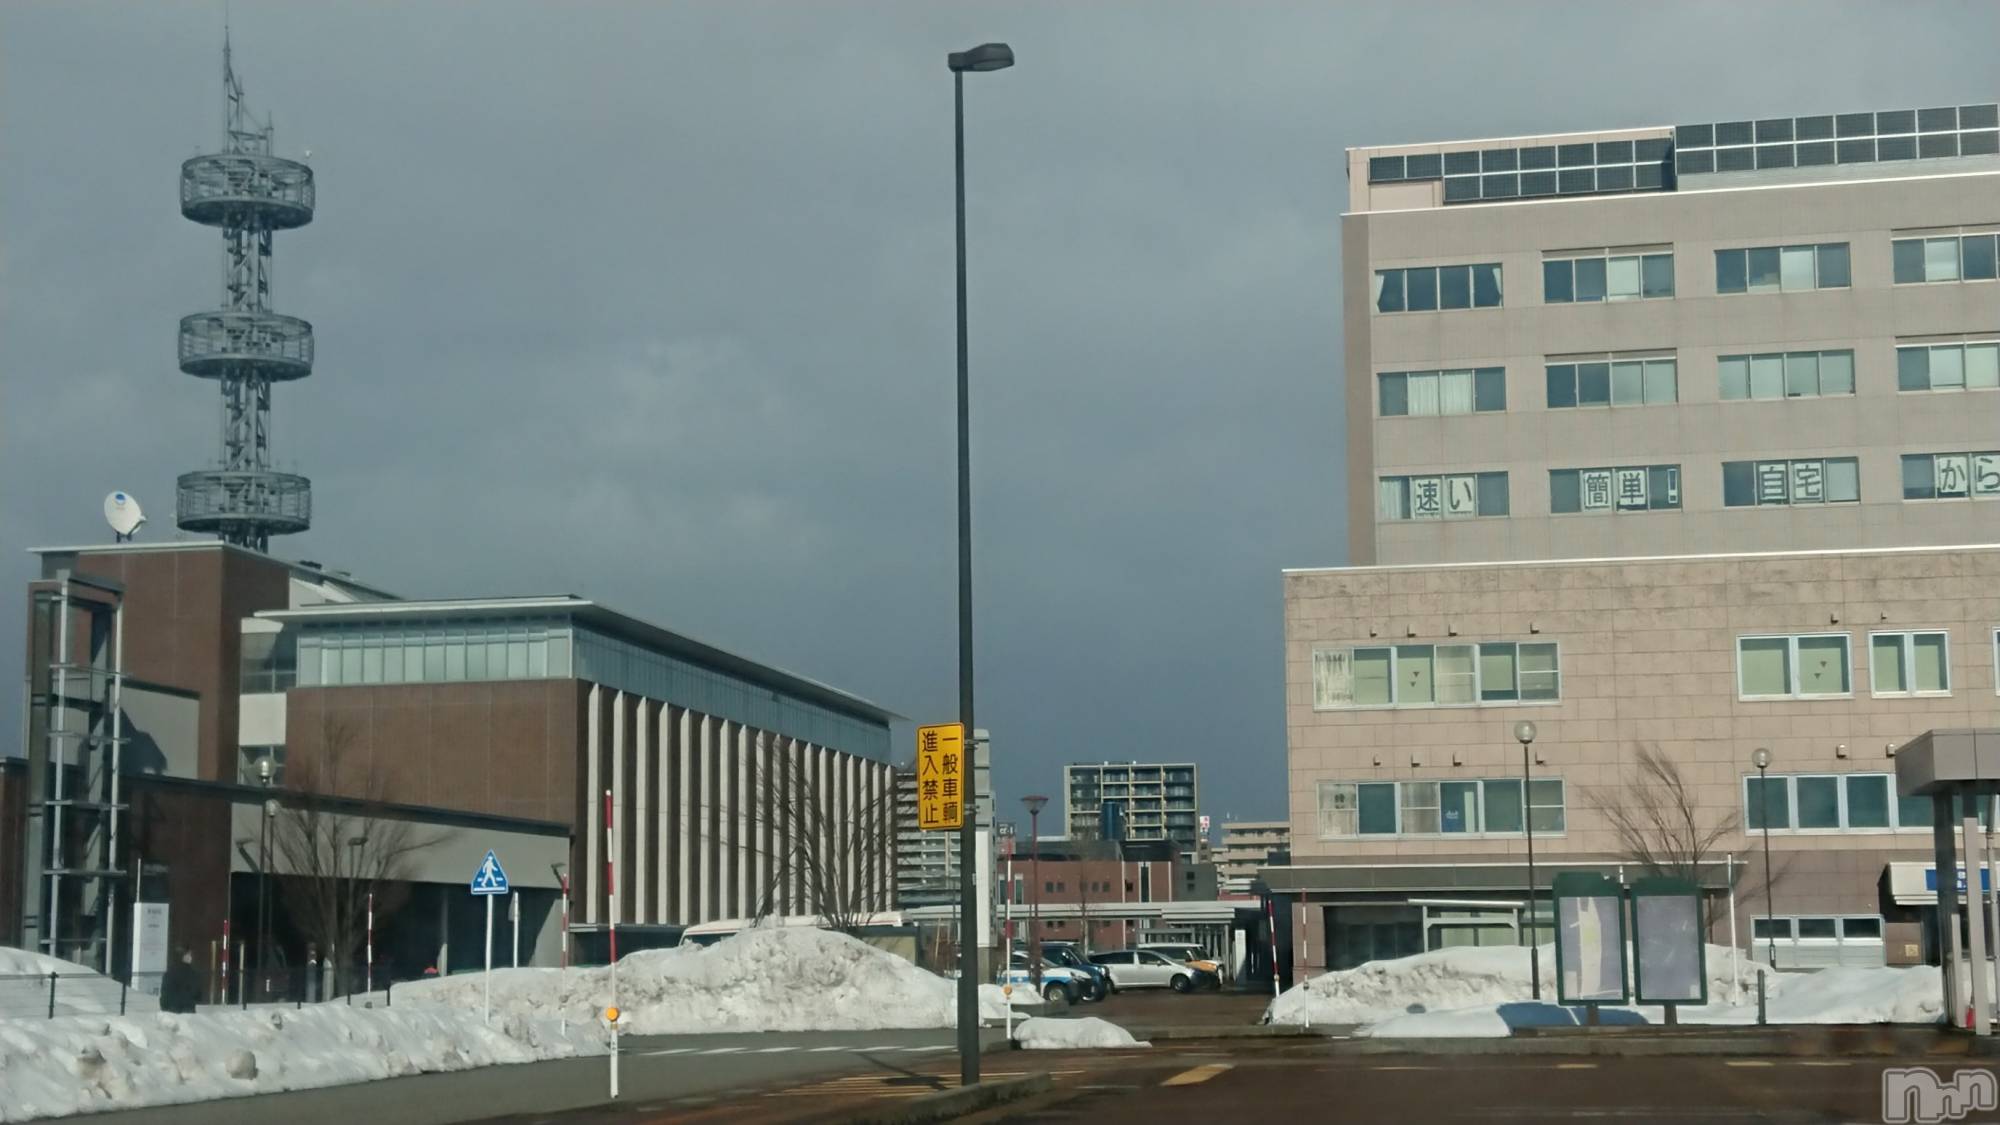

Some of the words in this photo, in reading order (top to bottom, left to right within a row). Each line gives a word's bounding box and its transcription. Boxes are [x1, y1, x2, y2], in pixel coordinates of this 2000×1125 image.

[1416, 480, 1472, 511] 速い
[1761, 465, 1820, 499] 自宅
[922, 731, 939, 824] 進入禁止
